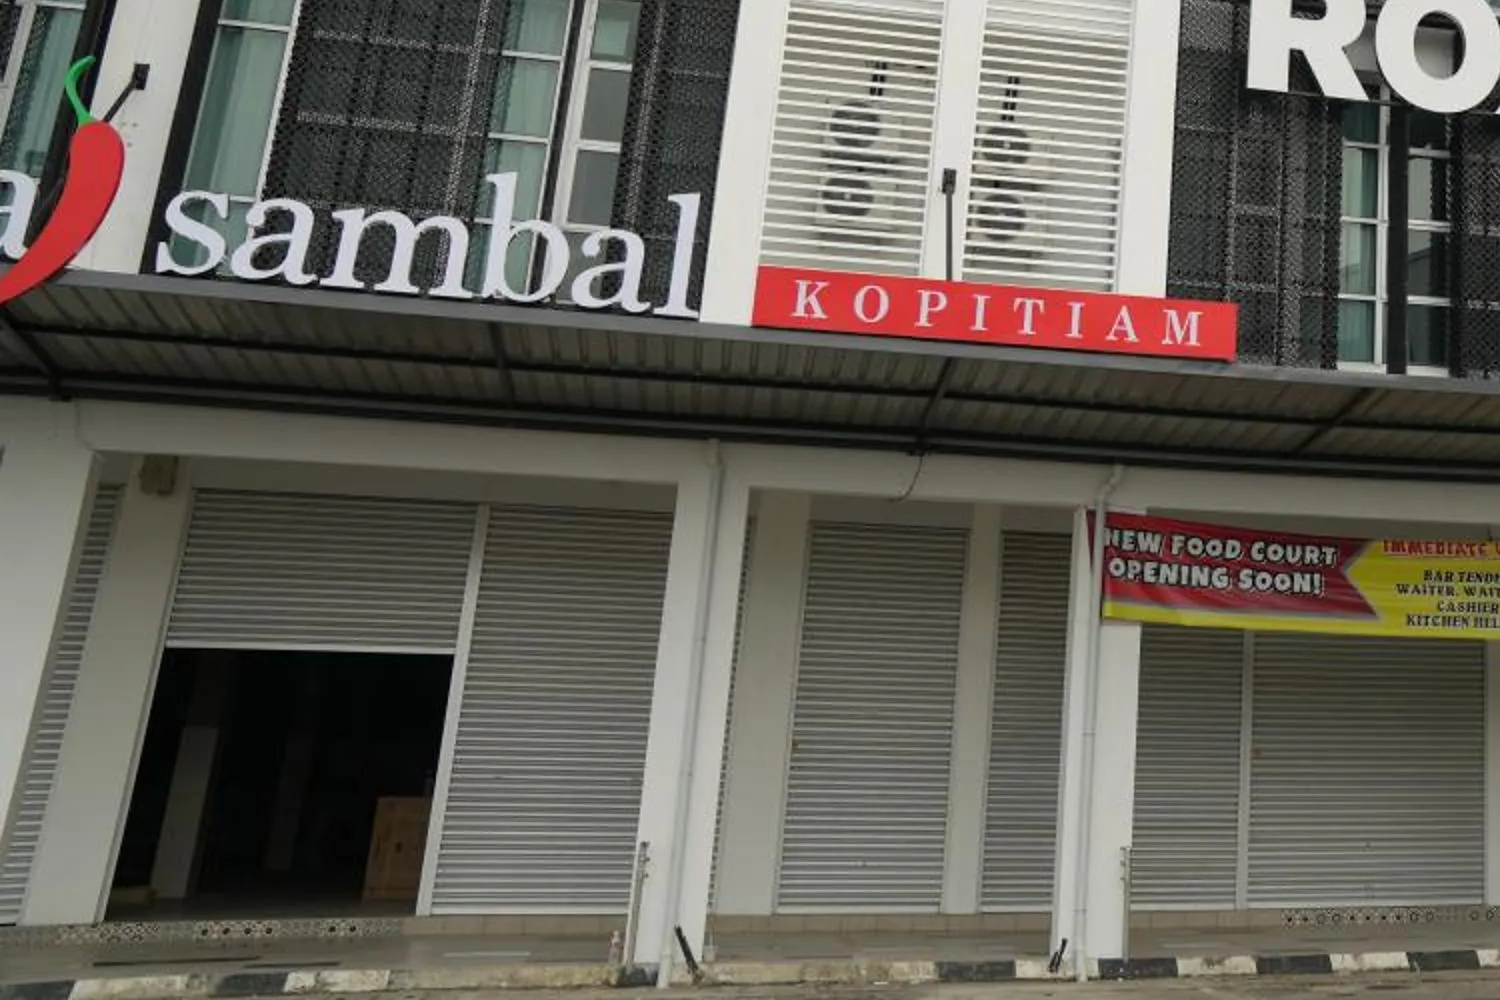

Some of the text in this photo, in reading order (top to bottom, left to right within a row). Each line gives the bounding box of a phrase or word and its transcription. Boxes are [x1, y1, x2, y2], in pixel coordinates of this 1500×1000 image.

[155, 172, 702, 319] sambal
[791, 279, 1203, 347] KOPITIAM
[1104, 527, 1337, 565] NEW FOOD COURT
[1383, 540, 1489, 557] IMMEDIATE
[1108, 557, 1324, 594] OPENING SOON!
[1423, 569, 1454, 583] BAR
[1407, 614, 1468, 628] KITCHEN
[1436, 601, 1499, 614] CASHIER
